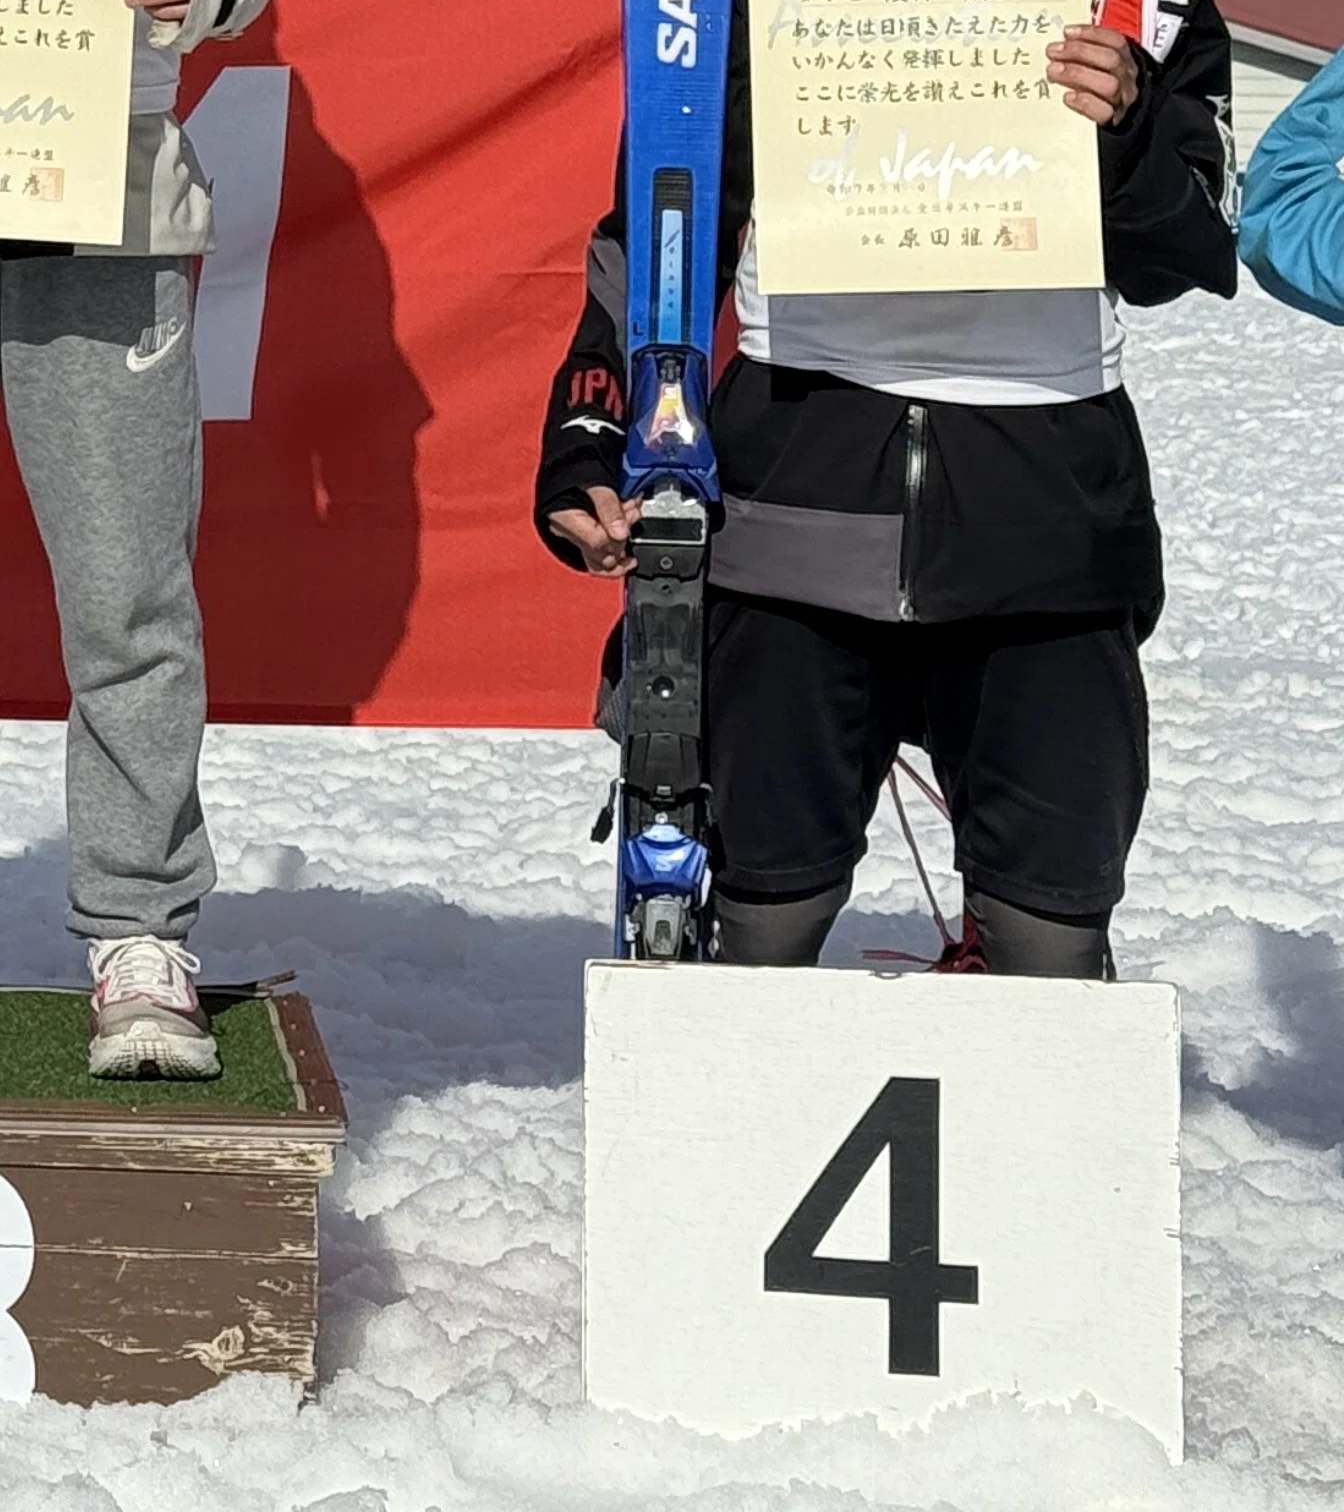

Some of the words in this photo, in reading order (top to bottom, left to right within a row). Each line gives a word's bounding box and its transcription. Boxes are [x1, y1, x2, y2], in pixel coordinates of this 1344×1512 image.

[793, 47, 1033, 70] いかんなく発揮しました
[764, 1076, 980, 1377] 4
